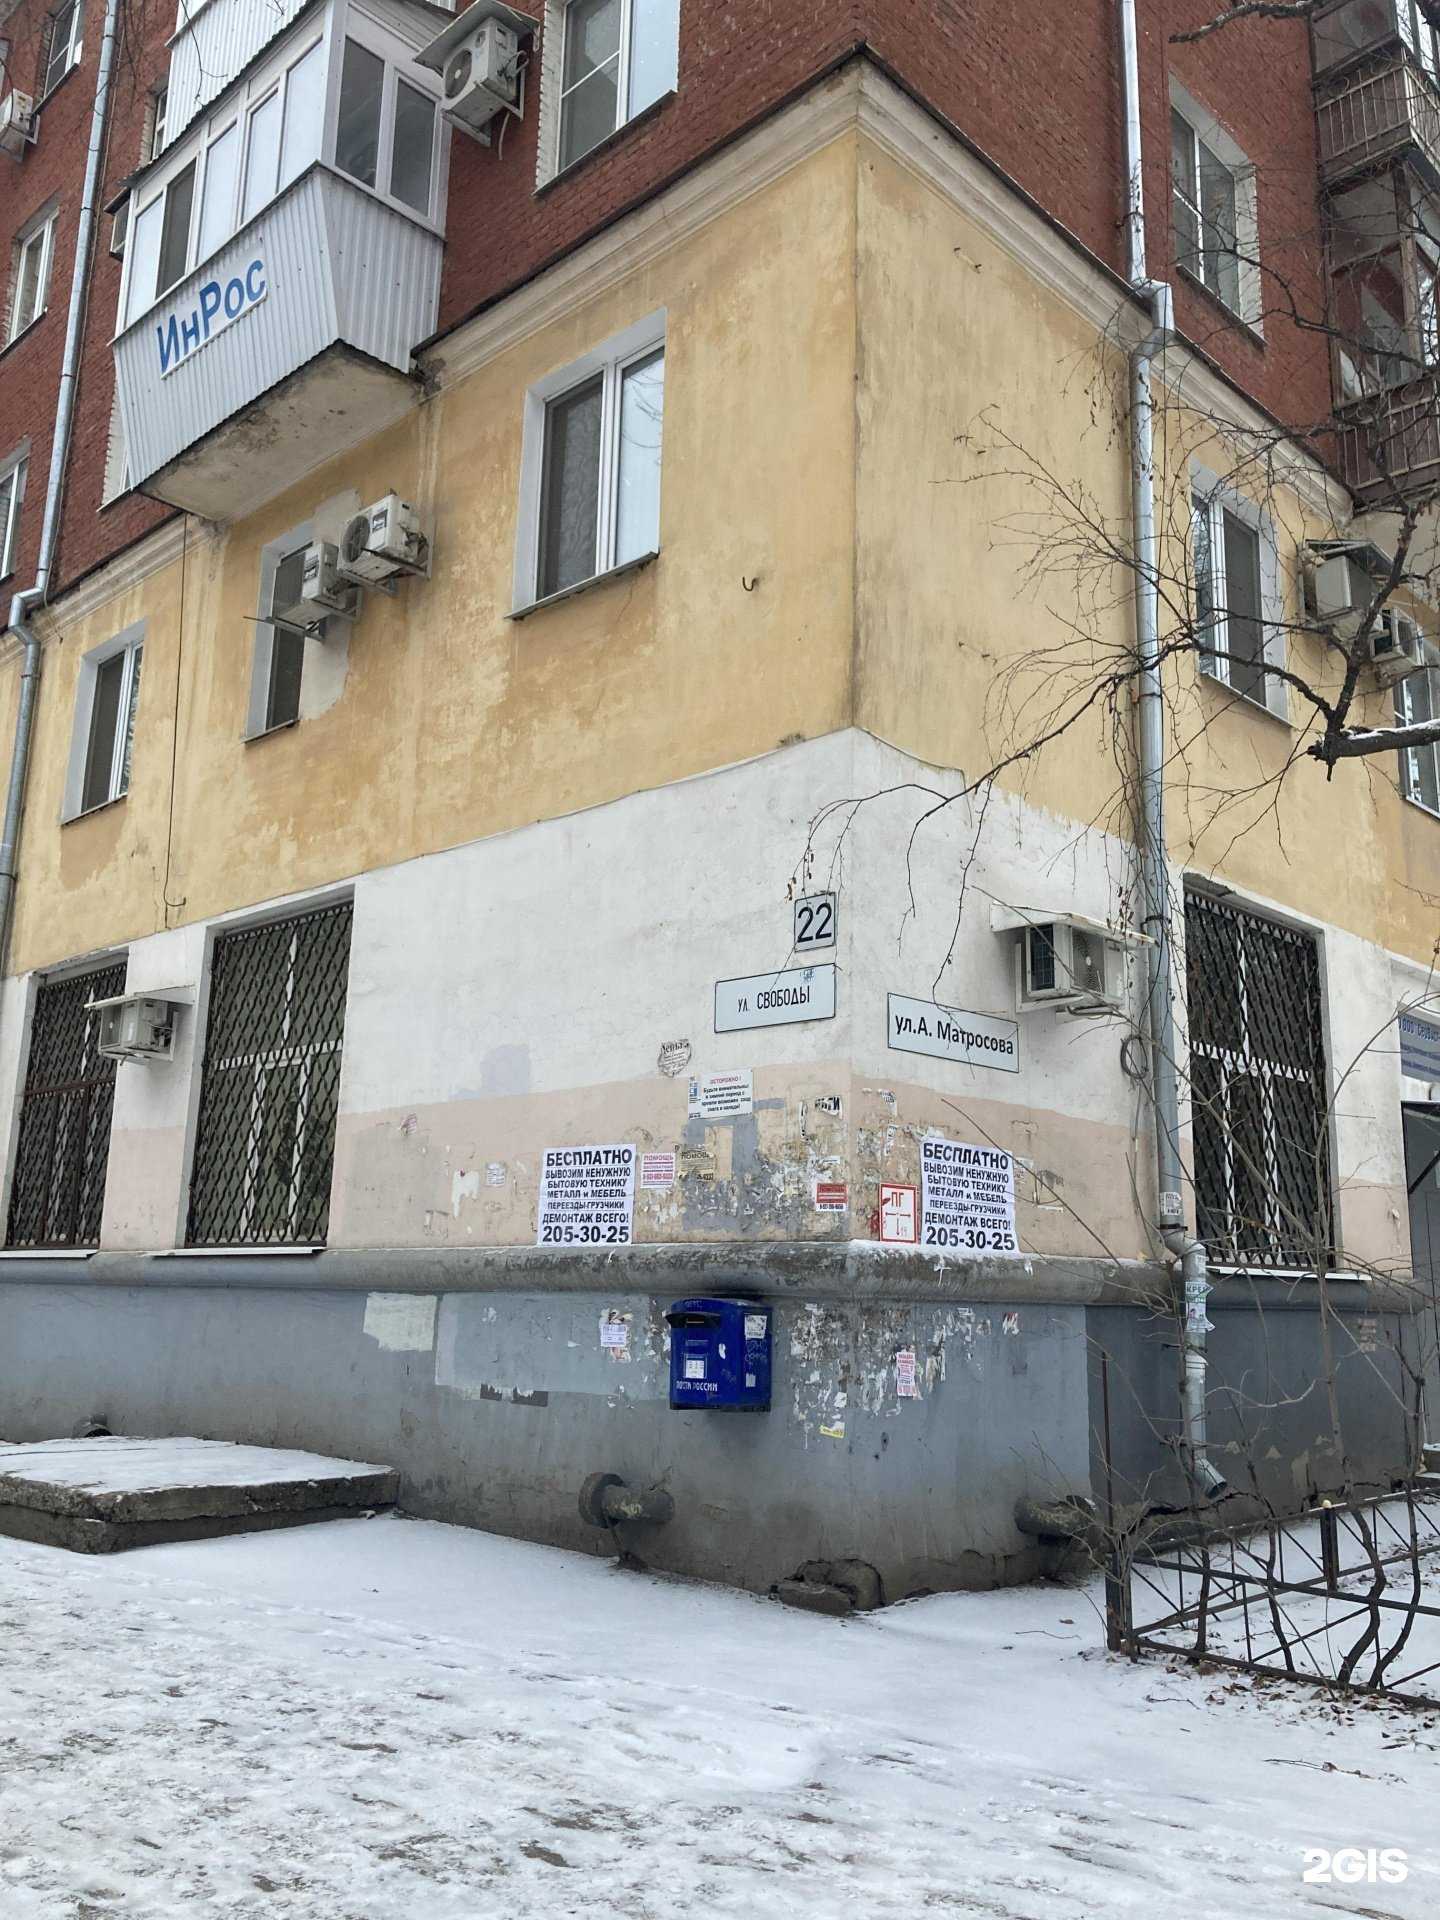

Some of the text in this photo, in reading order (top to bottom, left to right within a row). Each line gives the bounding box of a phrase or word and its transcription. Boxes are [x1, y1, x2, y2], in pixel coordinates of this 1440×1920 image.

[157, 260, 266, 374] ИнРос
[797, 902, 833, 943] 22
[757, 985, 810, 1010] СВОБОДЫ
[937, 1020, 1014, 1055] Матросова
[546, 1149, 632, 1166] БЕСПЛАТНО
[923, 1143, 1009, 1170] БЕСПЛАТНО
[546, 1168, 584, 1179] ВЫВОЗИМ
[586, 1166, 631, 1178] НЕНУЖНУЮ
[924, 1162, 1009, 1183] ВЫВОЗИМ НЕНУЖНУЮ
[548, 1178, 628, 1189] БЫТОВУЮ ТЕХНИКУ
[928, 1175, 1006, 1194] БЫТОВУЮ ТЕХНИКУ
[547, 1190, 581, 1199] МЕТАЛЛ
[590, 1188, 626, 1198] МЕБЕЛЬ
[891, 1192, 904, 1207] ПГ
[928, 1186, 964, 1200] МЕТАЛЛ
[973, 1192, 1007, 1204] МЕБЕЛЬ
[542, 1212, 629, 1224] ДЕМОНТАЖ ВСЕГО!
[924, 1212, 1011, 1231] ДЕМОНТАЖ ВСЕГО!
[542, 1225, 629, 1243] 205-30-25
[926, 1226, 1015, 1251] 205-30-25
